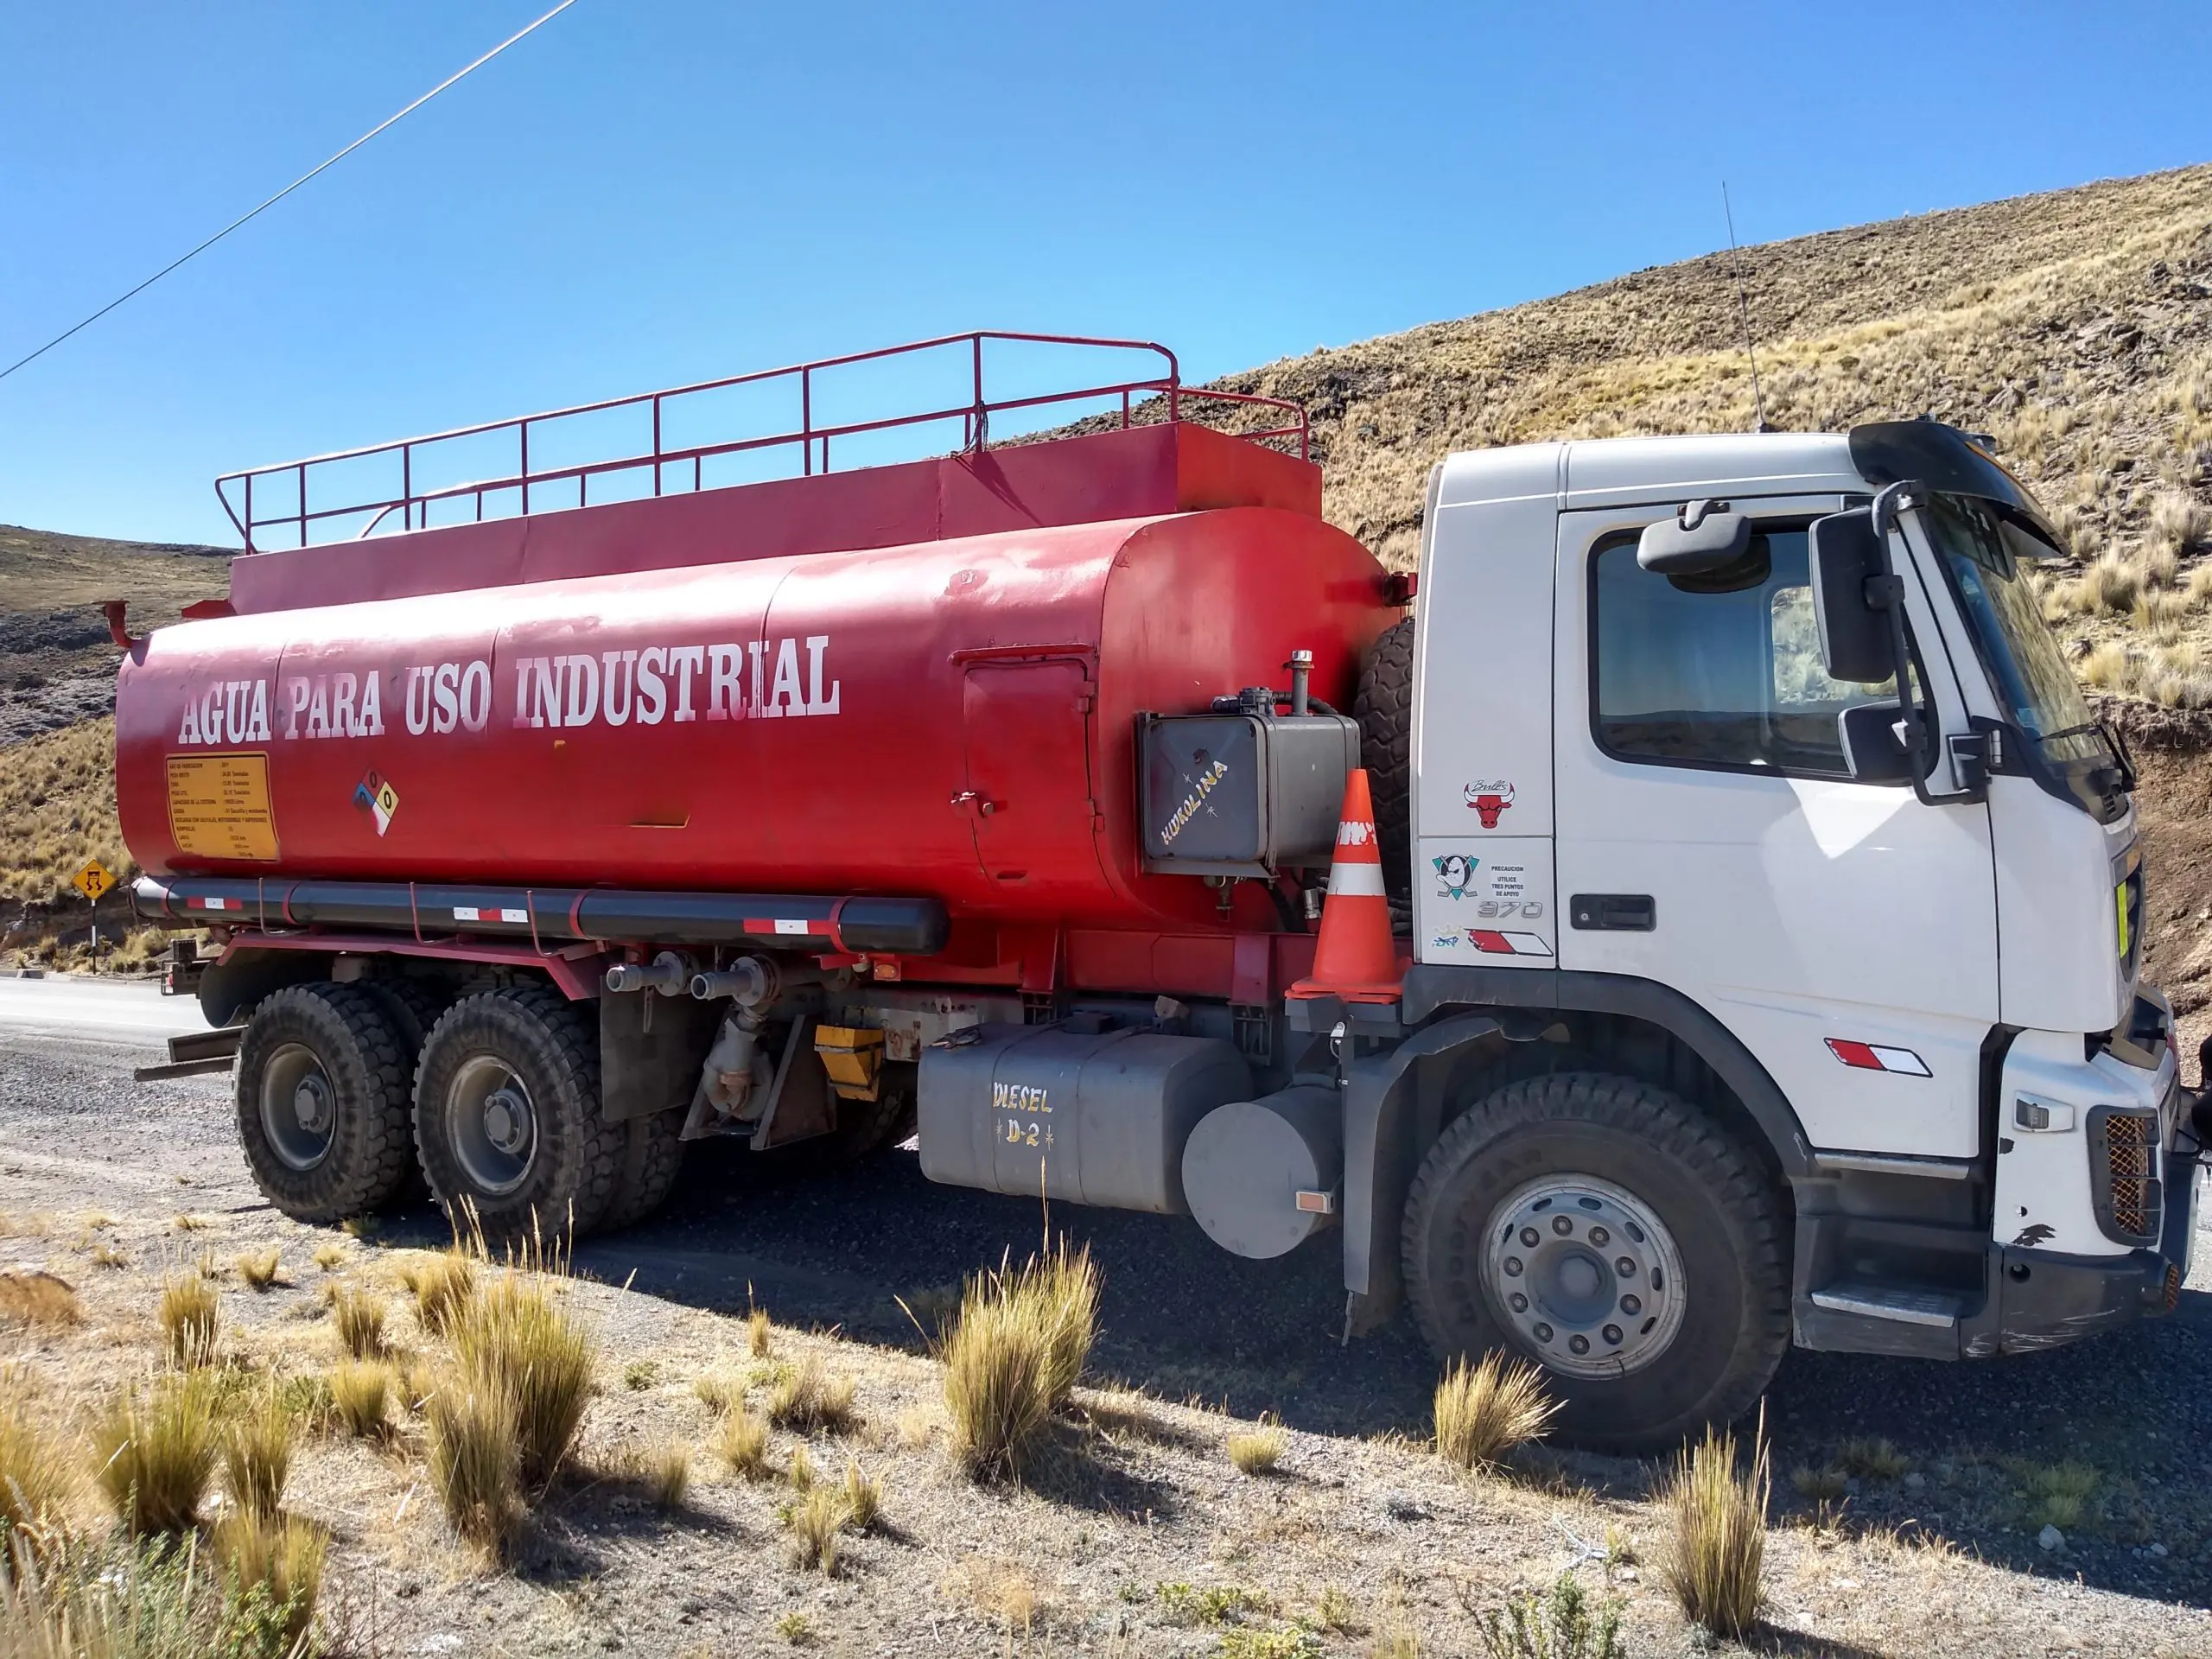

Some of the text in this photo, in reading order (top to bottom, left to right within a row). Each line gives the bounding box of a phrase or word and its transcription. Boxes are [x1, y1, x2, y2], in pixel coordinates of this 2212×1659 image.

[177, 635, 841, 745] AGUA PARA USO INDUSTRIAL
[370, 772, 377, 788] 0
[1471, 779, 1508, 792] Bulls
[384, 791, 392, 809] 0
[1160, 760, 1228, 845] HIDROLINA
[1477, 901, 1543, 919] 370
[992, 1081, 1054, 1114] DIESEL
[1006, 1118, 1040, 1147] D-2
